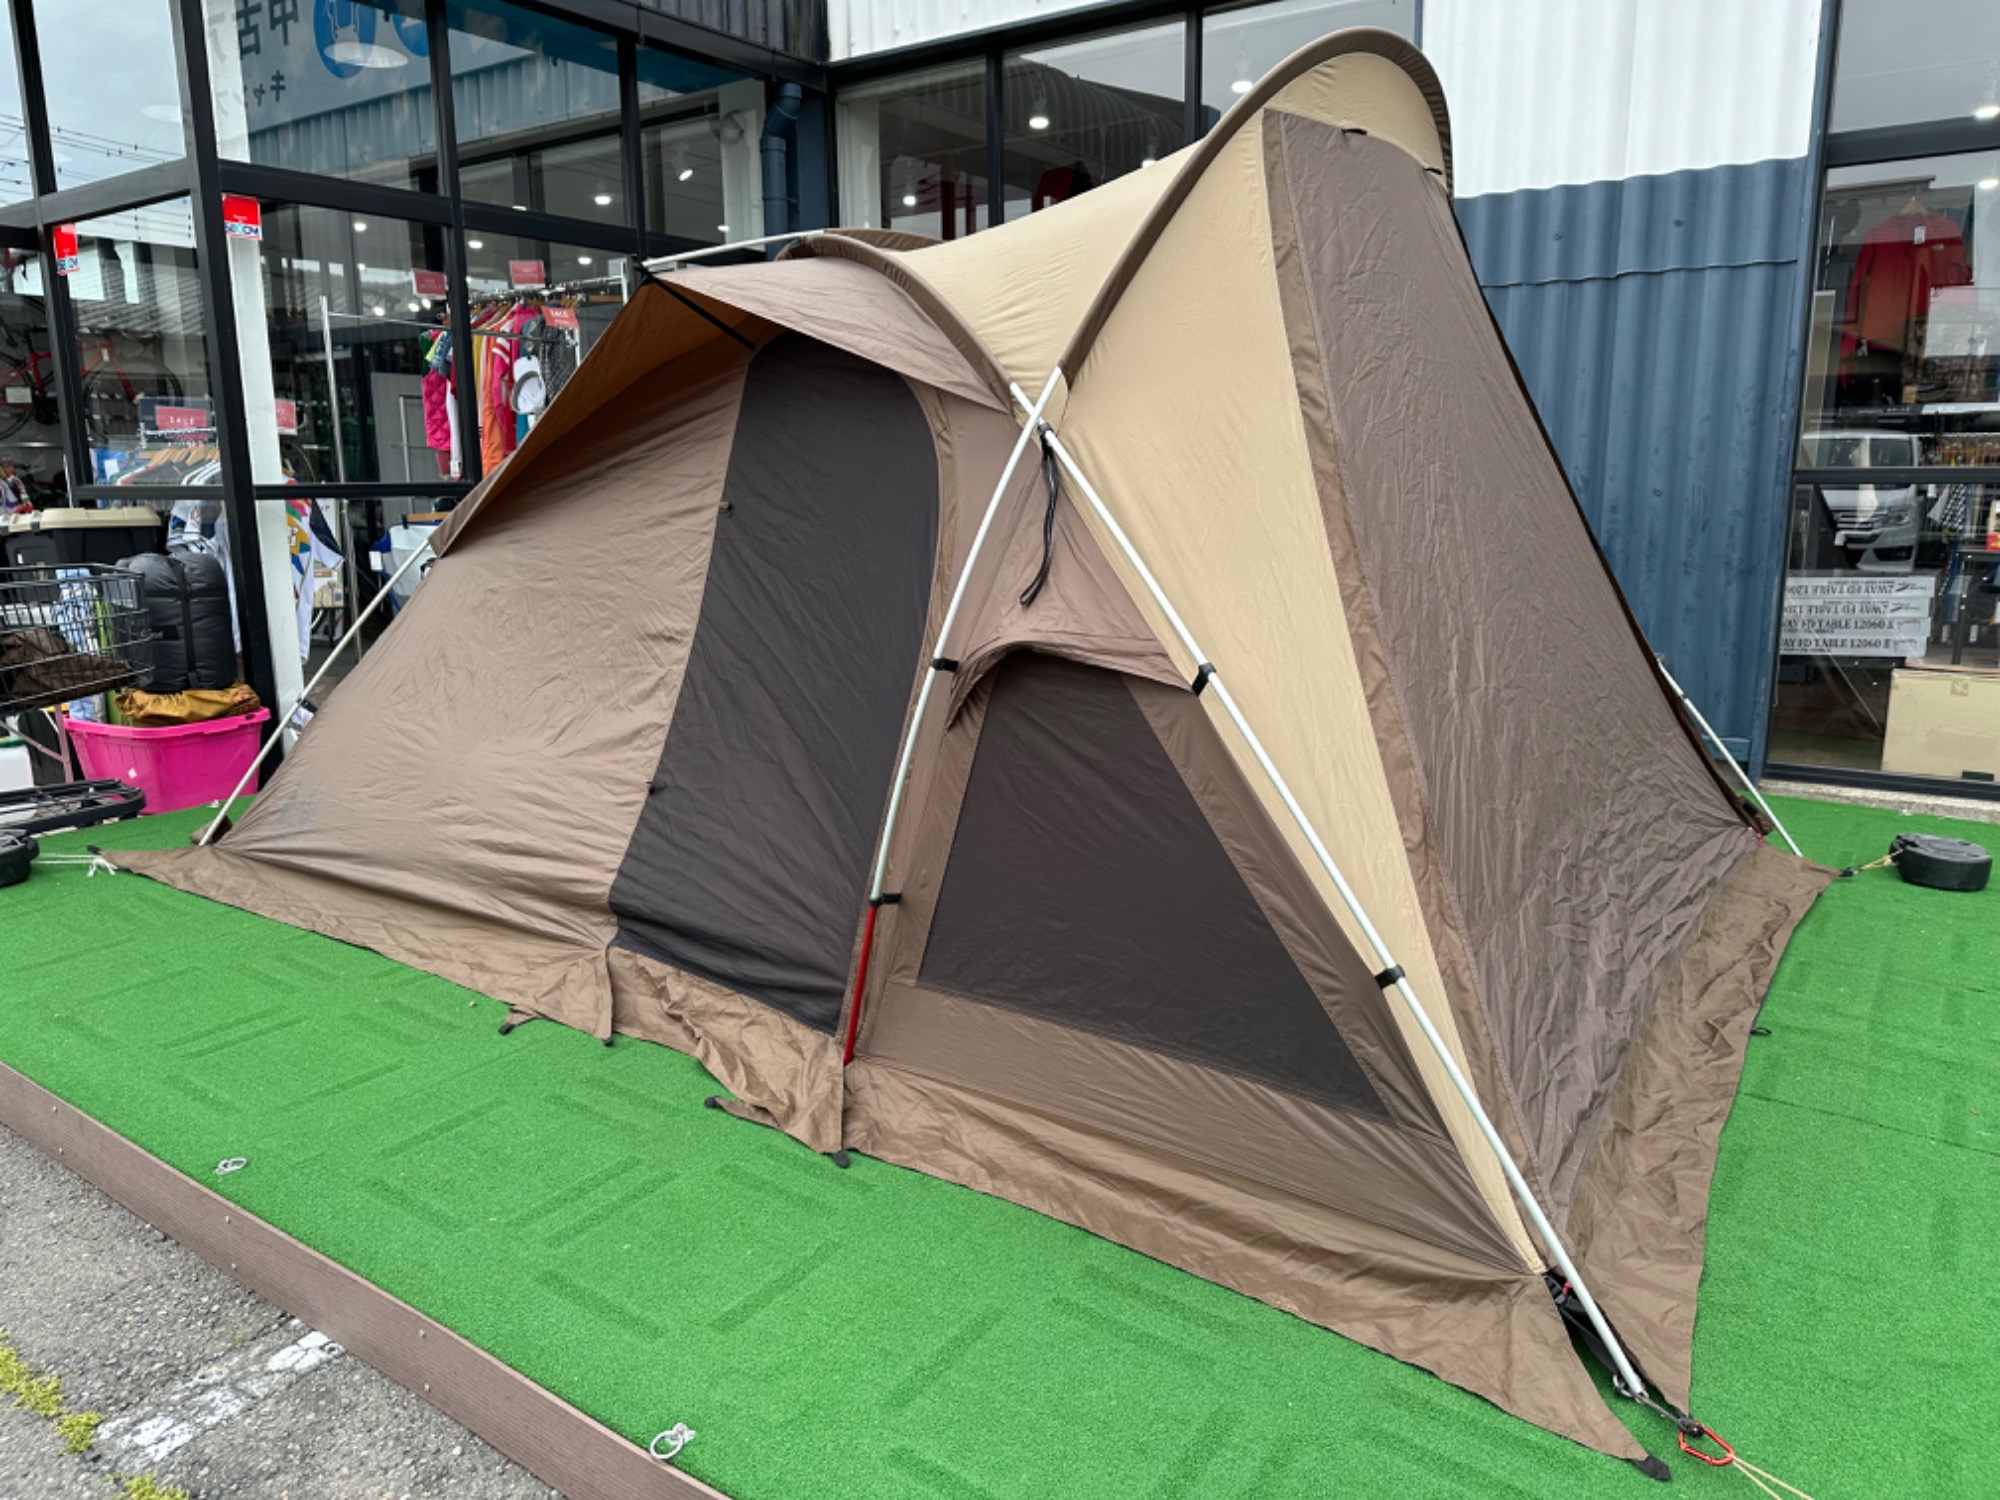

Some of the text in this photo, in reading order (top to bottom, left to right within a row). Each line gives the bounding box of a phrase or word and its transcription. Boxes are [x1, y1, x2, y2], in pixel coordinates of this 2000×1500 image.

[1812, 584, 1844, 594] TABLE
[1807, 604, 1839, 614] TABLE
[1818, 619, 1851, 629] TABLE
[1814, 638, 1848, 648] TABLE
[1850, 638, 1882, 649] 12060
